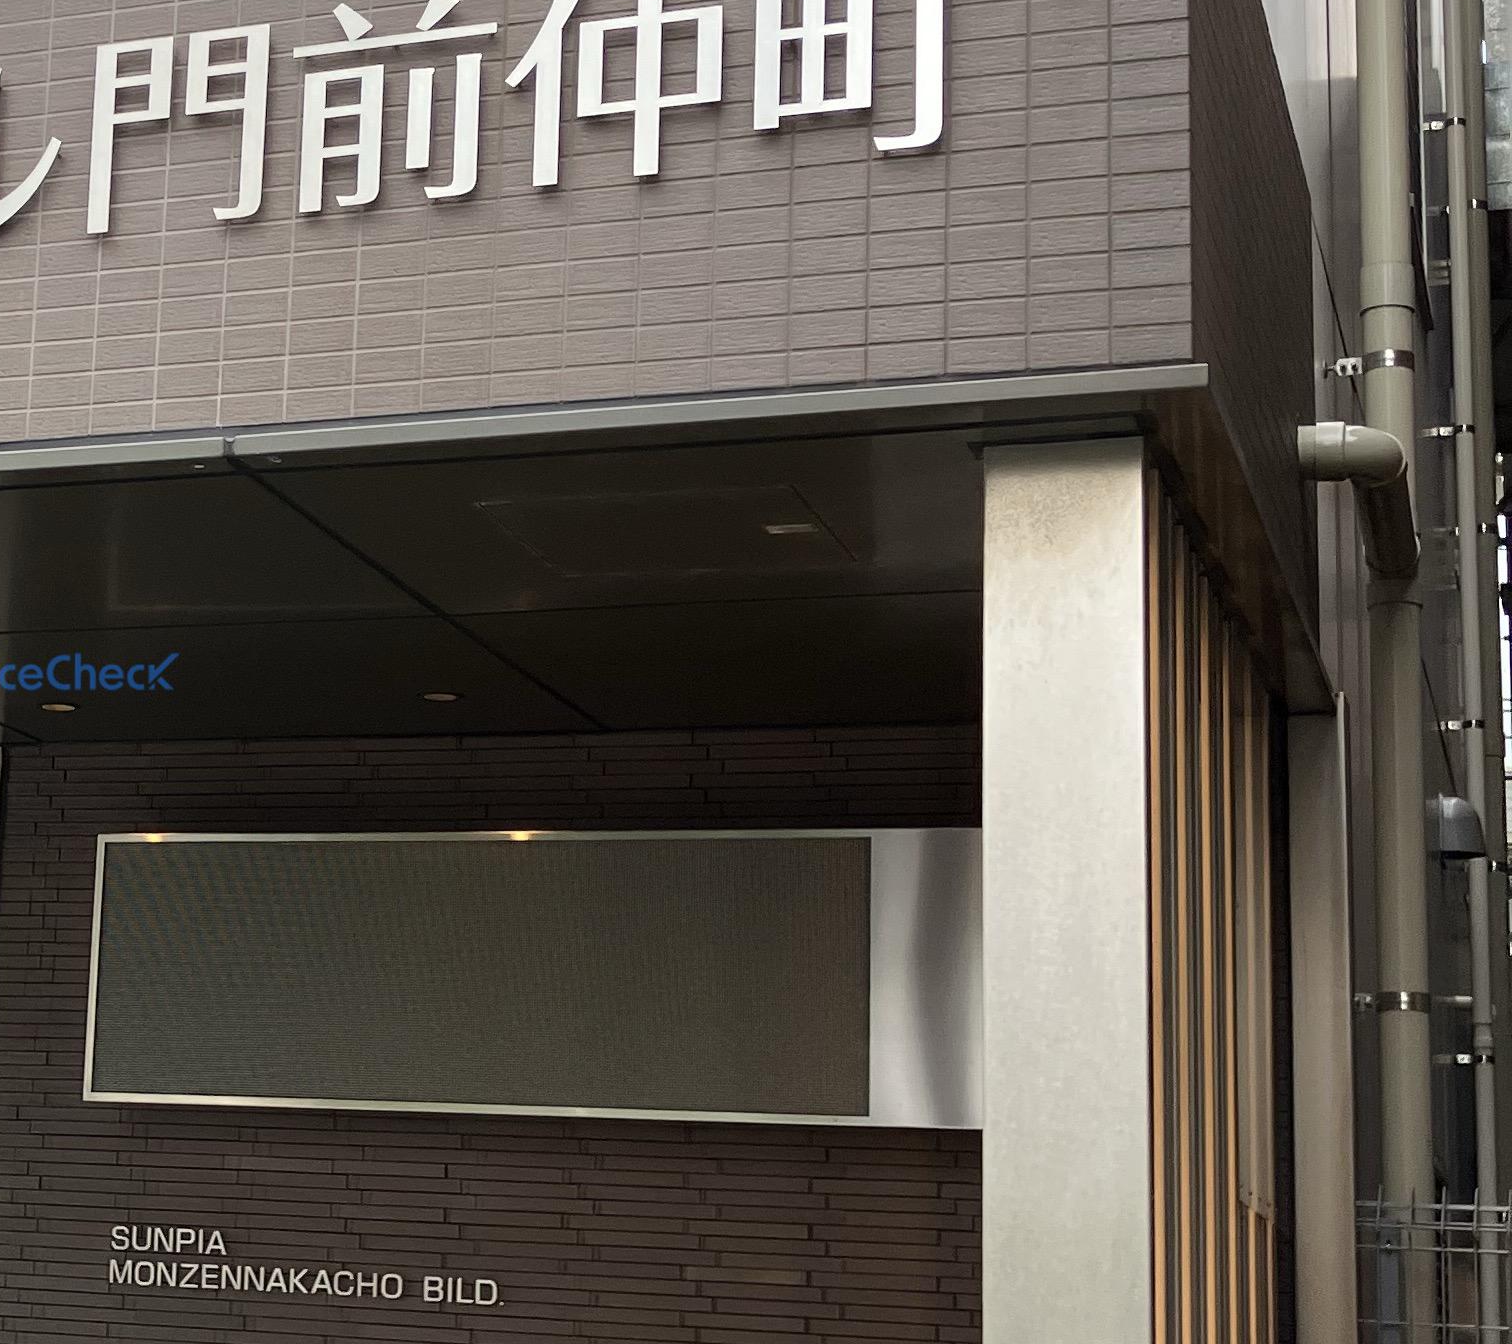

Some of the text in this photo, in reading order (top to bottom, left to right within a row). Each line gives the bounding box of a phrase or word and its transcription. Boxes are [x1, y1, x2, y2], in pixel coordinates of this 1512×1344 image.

[110, 1225, 227, 1256] SUNPIA
[108, 1259, 506, 1307] MONZENNAKACHO BILD.
